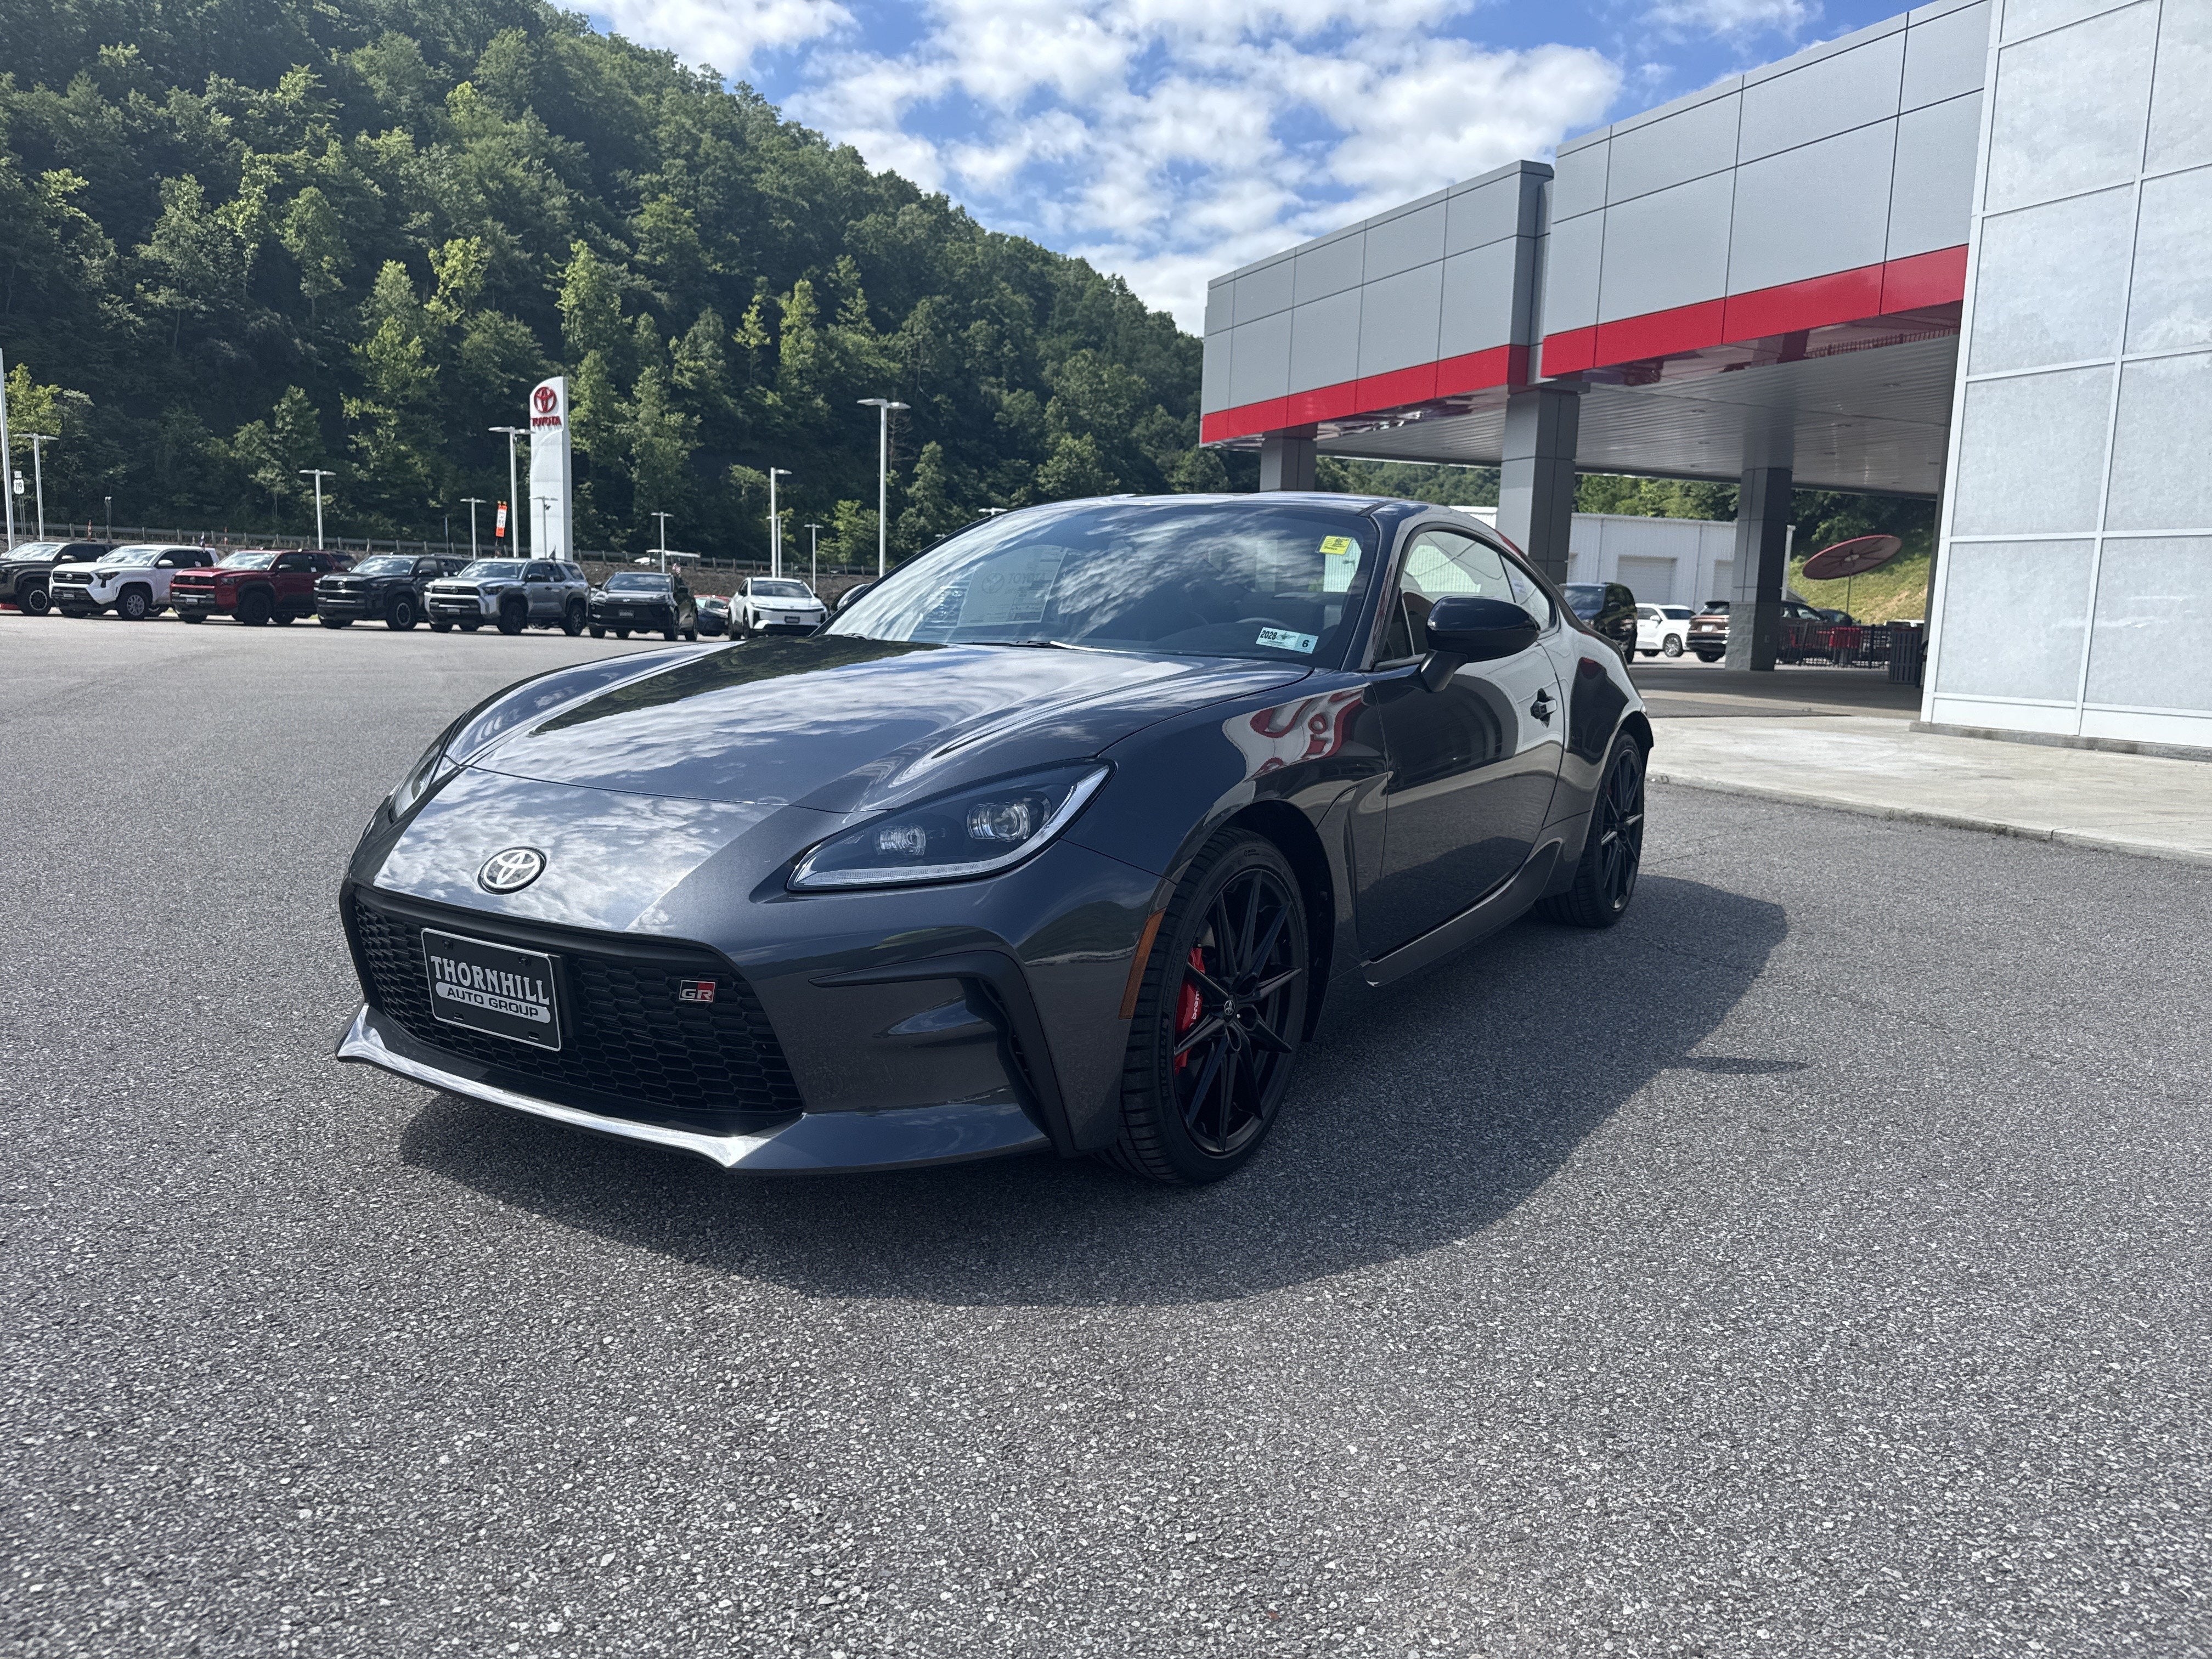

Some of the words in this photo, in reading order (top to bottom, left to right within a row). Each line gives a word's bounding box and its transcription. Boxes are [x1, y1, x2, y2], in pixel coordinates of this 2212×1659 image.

[531, 416, 562, 426] TOYOTA
[1260, 630, 1277, 640] 2028
[430, 955, 550, 1005] THORNHILL
[681, 989, 713, 1000] GR
[447, 987, 484, 1005] AUTO
[488, 997, 538, 1017] GROUP
